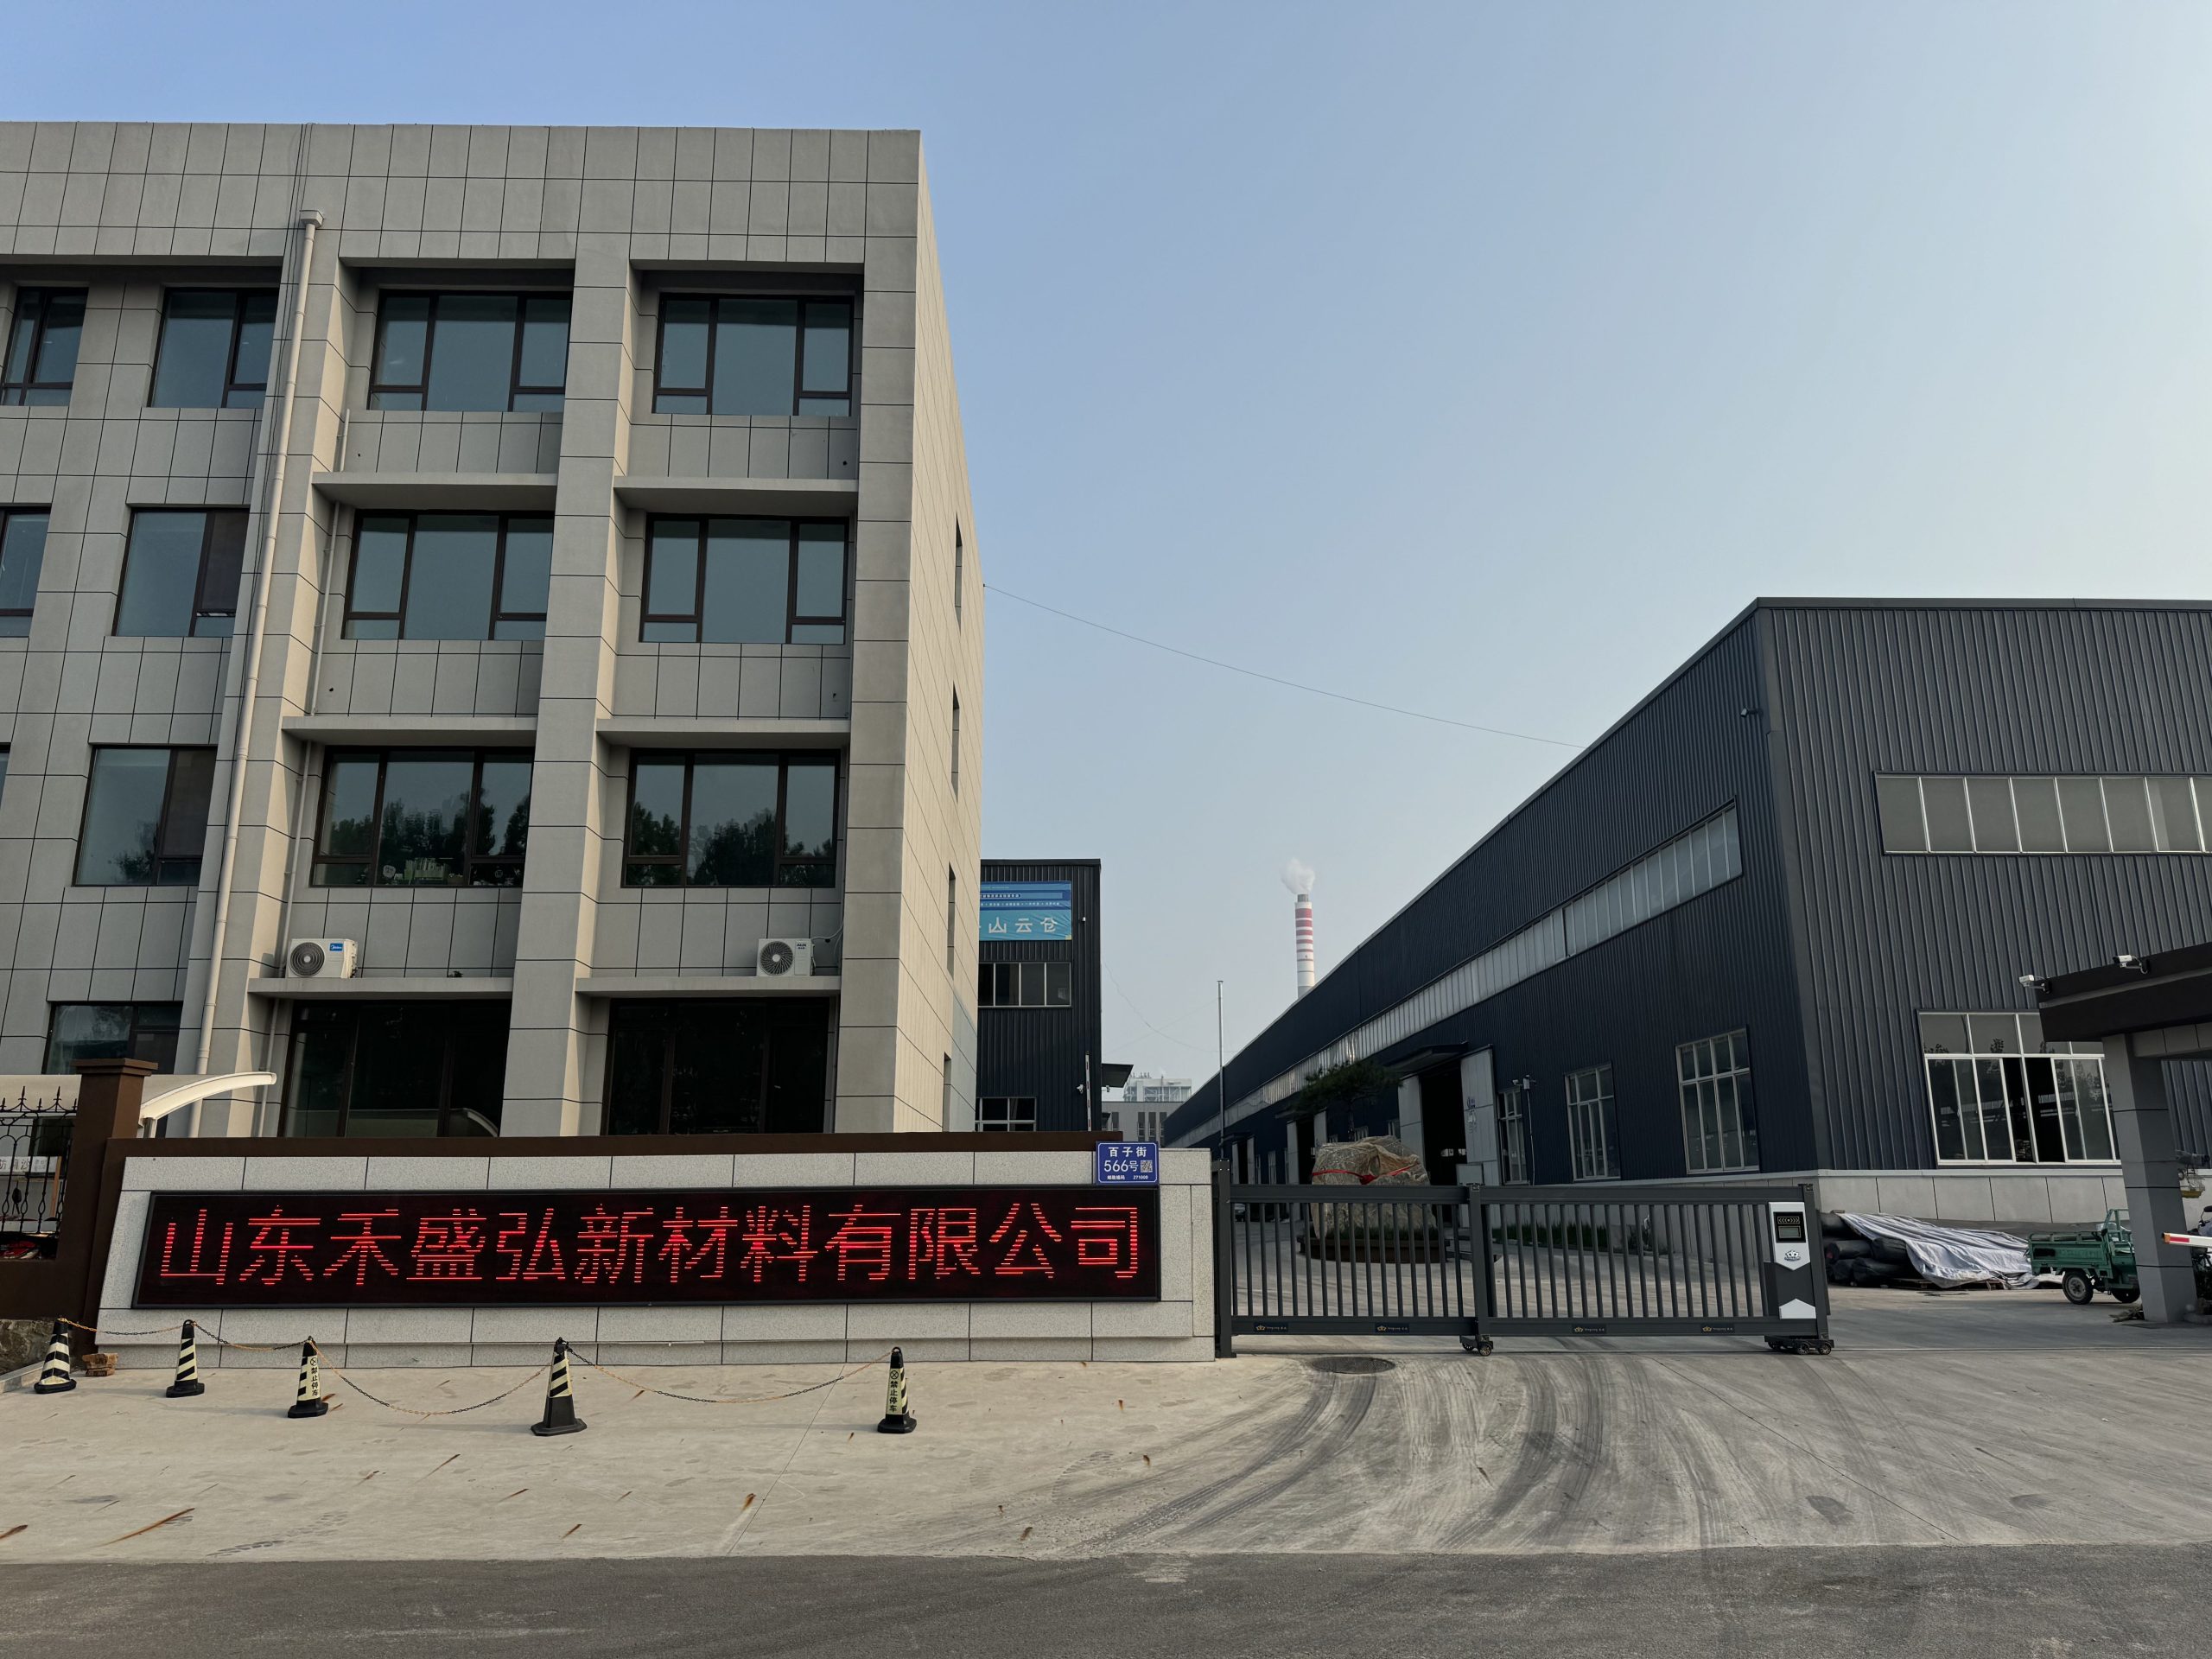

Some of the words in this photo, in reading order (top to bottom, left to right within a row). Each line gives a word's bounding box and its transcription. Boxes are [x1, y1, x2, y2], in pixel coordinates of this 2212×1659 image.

[979, 917, 1058, 933] 山云仓
[1108, 1146, 1147, 1158] 百子街
[1103, 1160, 1139, 1173] 566号
[161, 1204, 1137, 1285] 山东禾盛弘新材料有限公司
[888, 1381, 899, 1413] 禁止停车
